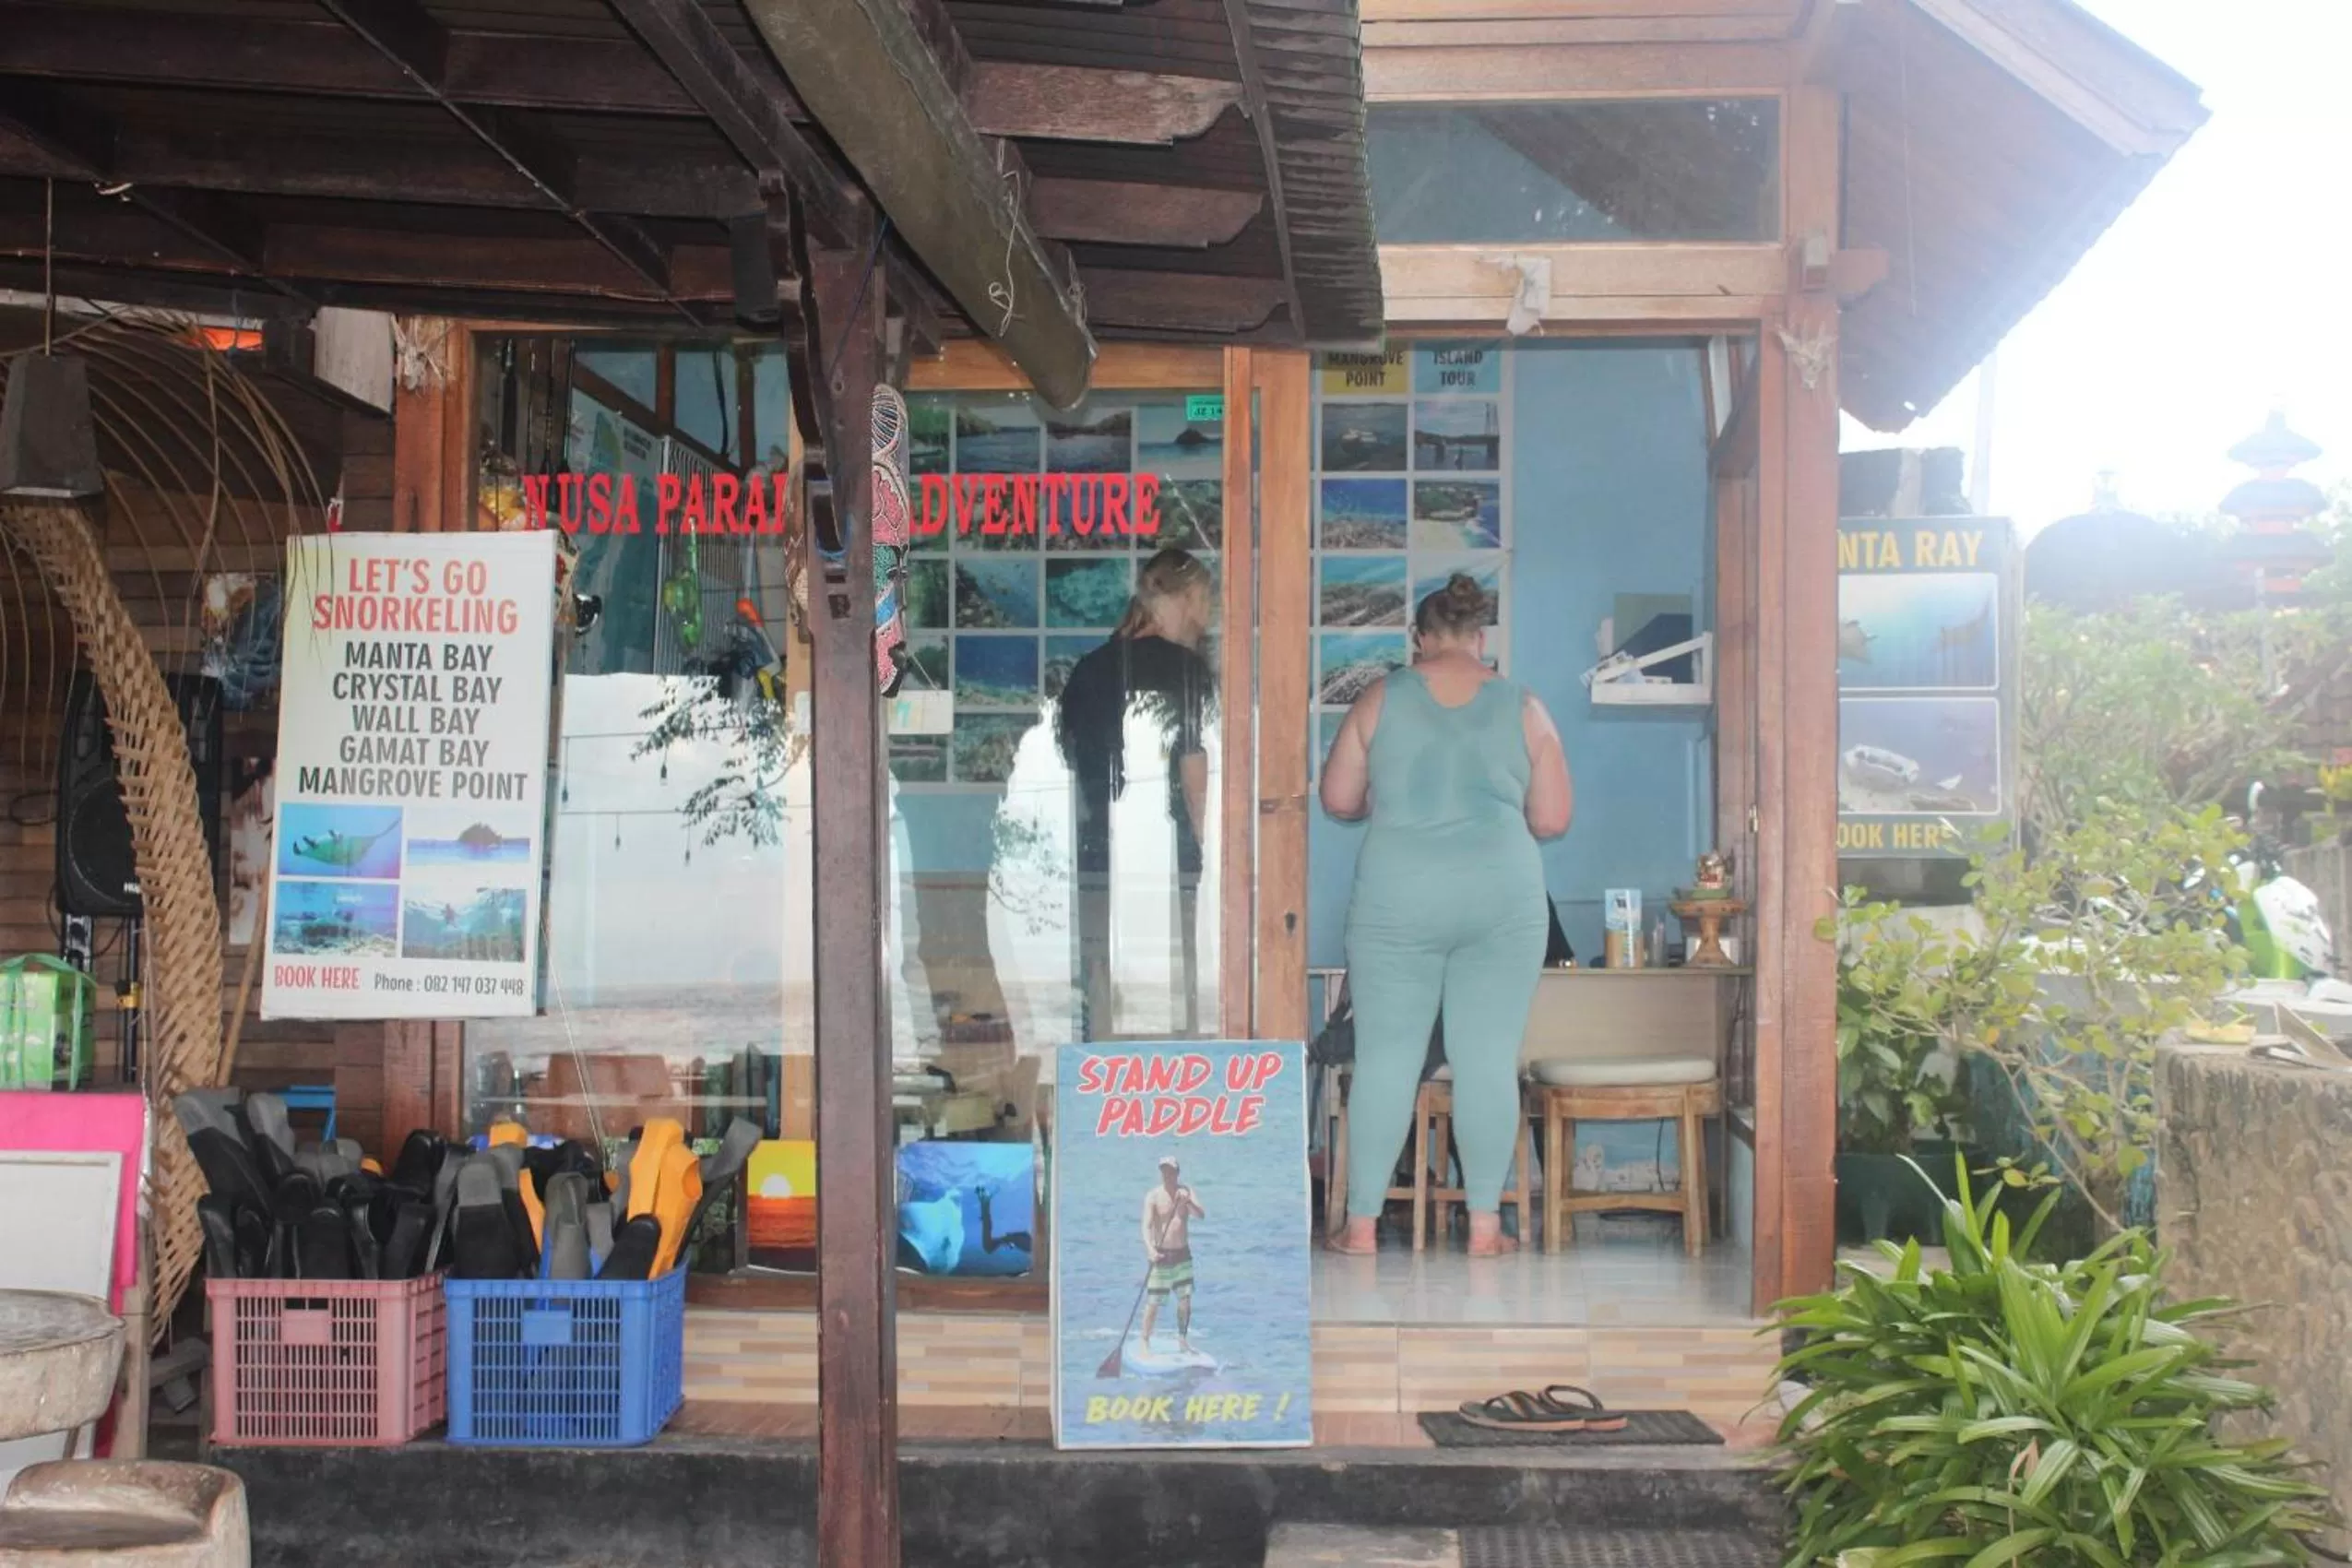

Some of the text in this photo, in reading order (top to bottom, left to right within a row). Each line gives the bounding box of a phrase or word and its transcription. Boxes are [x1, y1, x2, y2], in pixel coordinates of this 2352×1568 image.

[1433, 350, 1483, 366] ISLAND
[1346, 371, 1386, 387] POINT
[1440, 371, 1475, 386] TOUR
[523, 472, 641, 534] NUSA
[909, 472, 1161, 536] DVENTURE
[1836, 529, 1983, 569] NTA RAY
[349, 558, 488, 596] LET'S GO
[312, 594, 518, 635] SNORKELING
[345, 641, 494, 672] MANTA BAY
[332, 672, 504, 704] CRYSTAL BAY
[352, 704, 481, 735] WALL BAY
[339, 735, 491, 768] GAMAT BAY
[298, 766, 529, 802] MANGROVE POINT
[1835, 822, 1884, 849] OOK
[274, 965, 361, 990] BOOK HERE
[374, 972, 413, 992] Phone
[423, 975, 449, 993] 082
[451, 976, 471, 995] 147
[474, 977, 497, 995] 037
[500, 978, 525, 996] 448
[1077, 1051, 1283, 1095] STAND UP
[1096, 1095, 1266, 1137] PADDLE
[1085, 1394, 1173, 1425] BOOK
[1184, 1392, 1264, 1422] HERE
